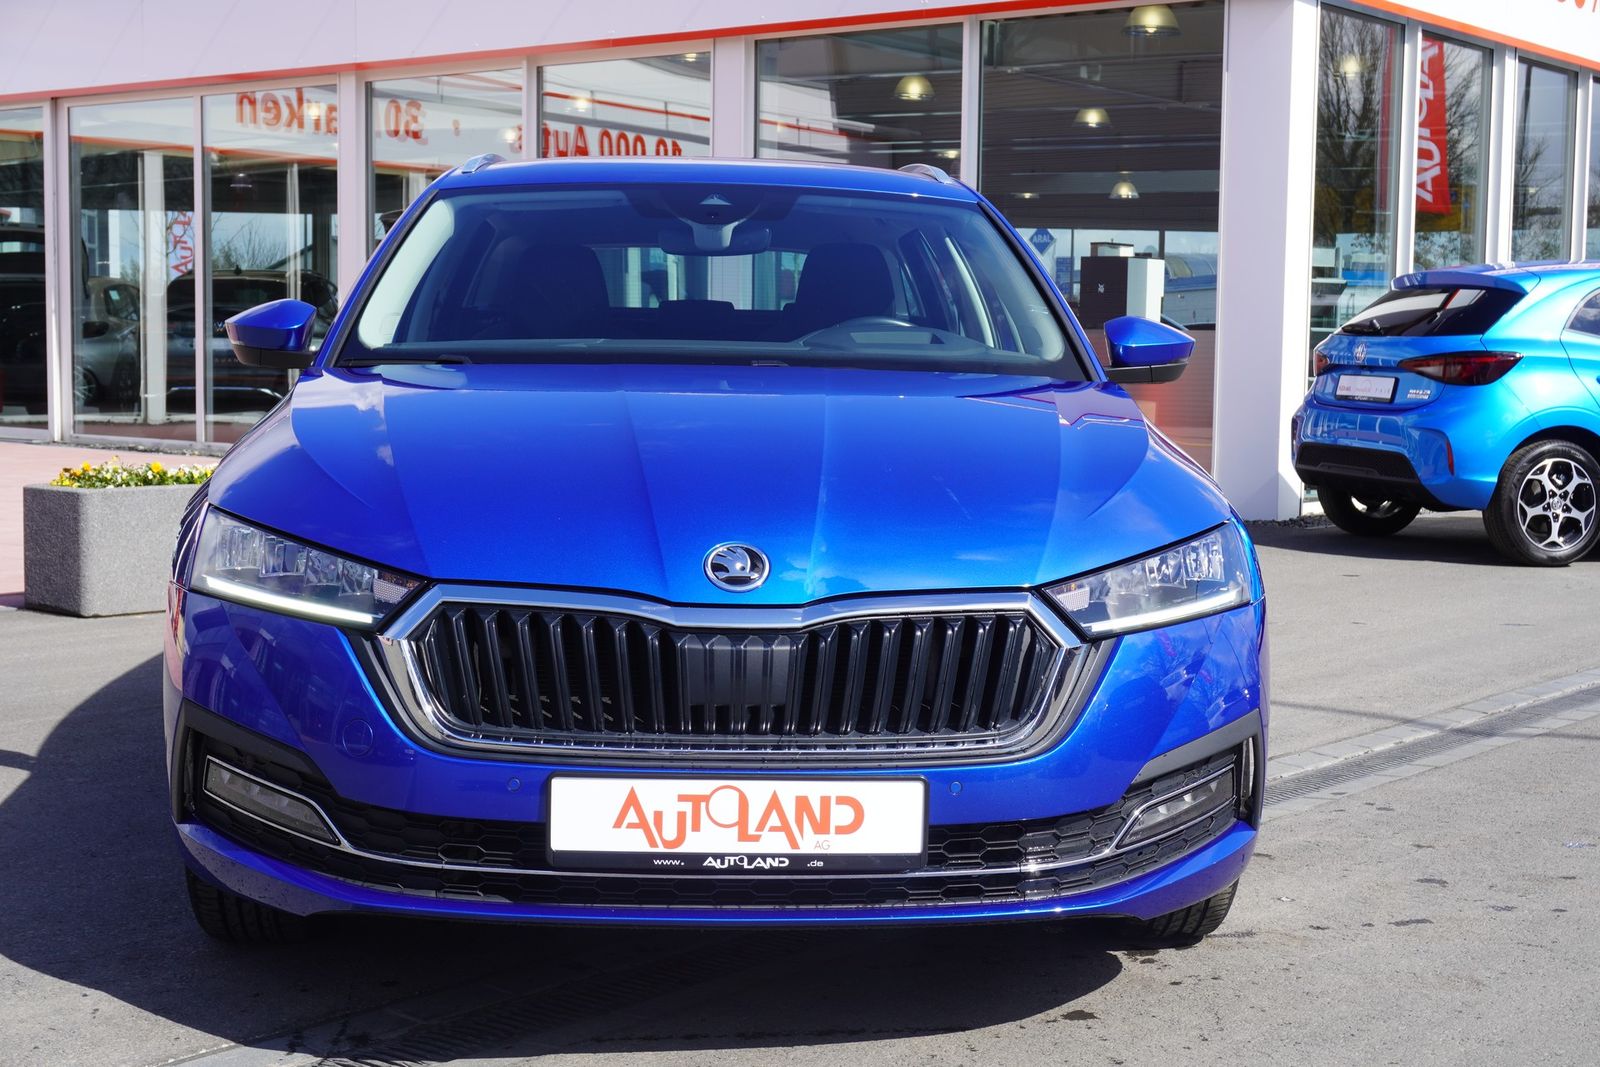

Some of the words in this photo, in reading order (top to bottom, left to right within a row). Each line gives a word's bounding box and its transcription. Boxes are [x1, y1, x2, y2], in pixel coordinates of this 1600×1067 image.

[1032, 234, 1050, 243] ARAL
[612, 785, 865, 850] AUTOLAND
[814, 840, 831, 851] AG
[653, 858, 685, 867] www.
[703, 855, 789, 870] AUTOLAND
[807, 858, 824, 867] .de
